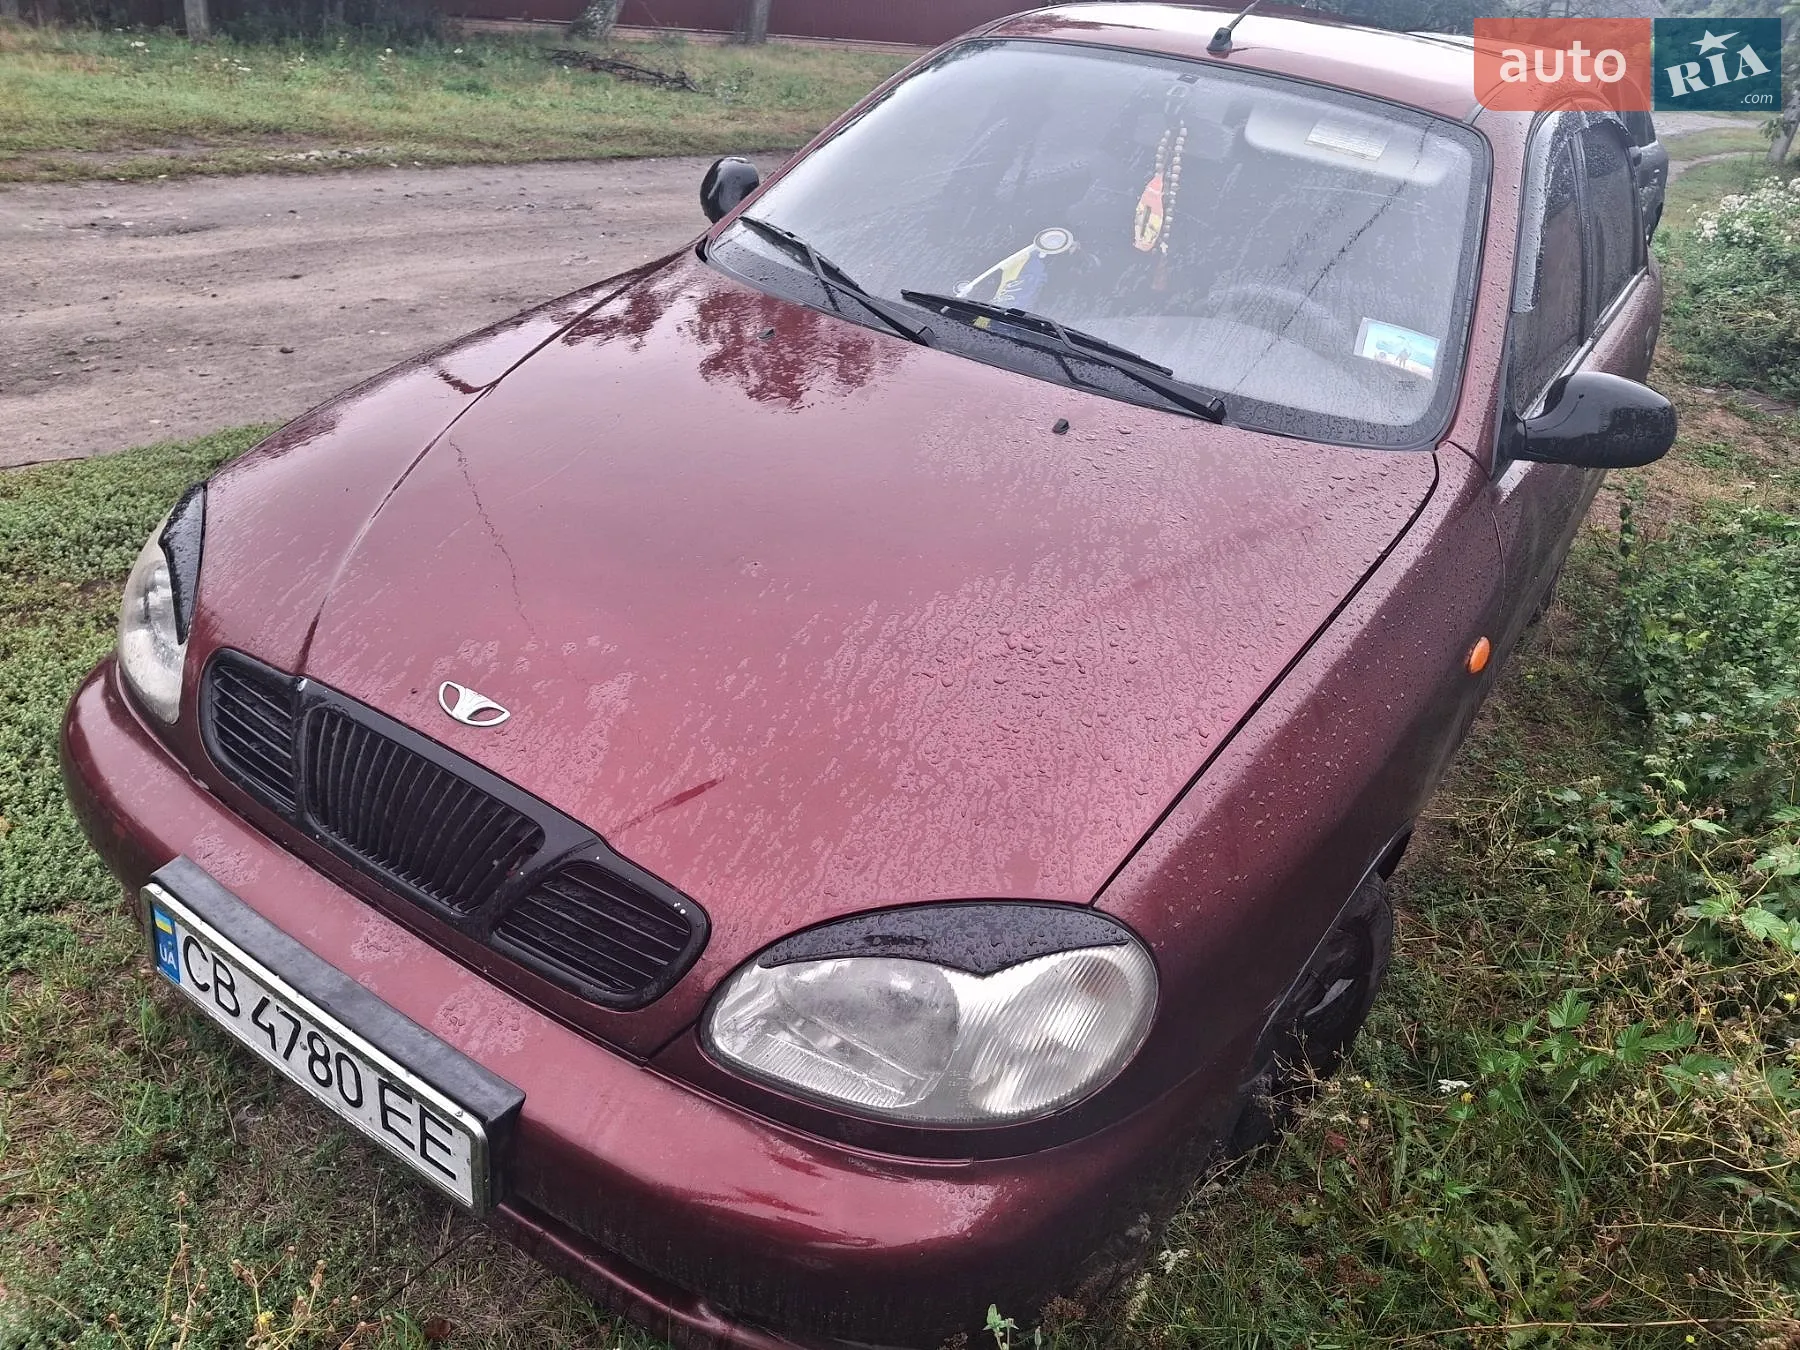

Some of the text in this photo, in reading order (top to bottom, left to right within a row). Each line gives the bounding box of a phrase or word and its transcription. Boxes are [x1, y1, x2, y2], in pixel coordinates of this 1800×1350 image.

[159, 946, 176, 967] UA
[183, 935, 456, 1181] CB 4780 EE
